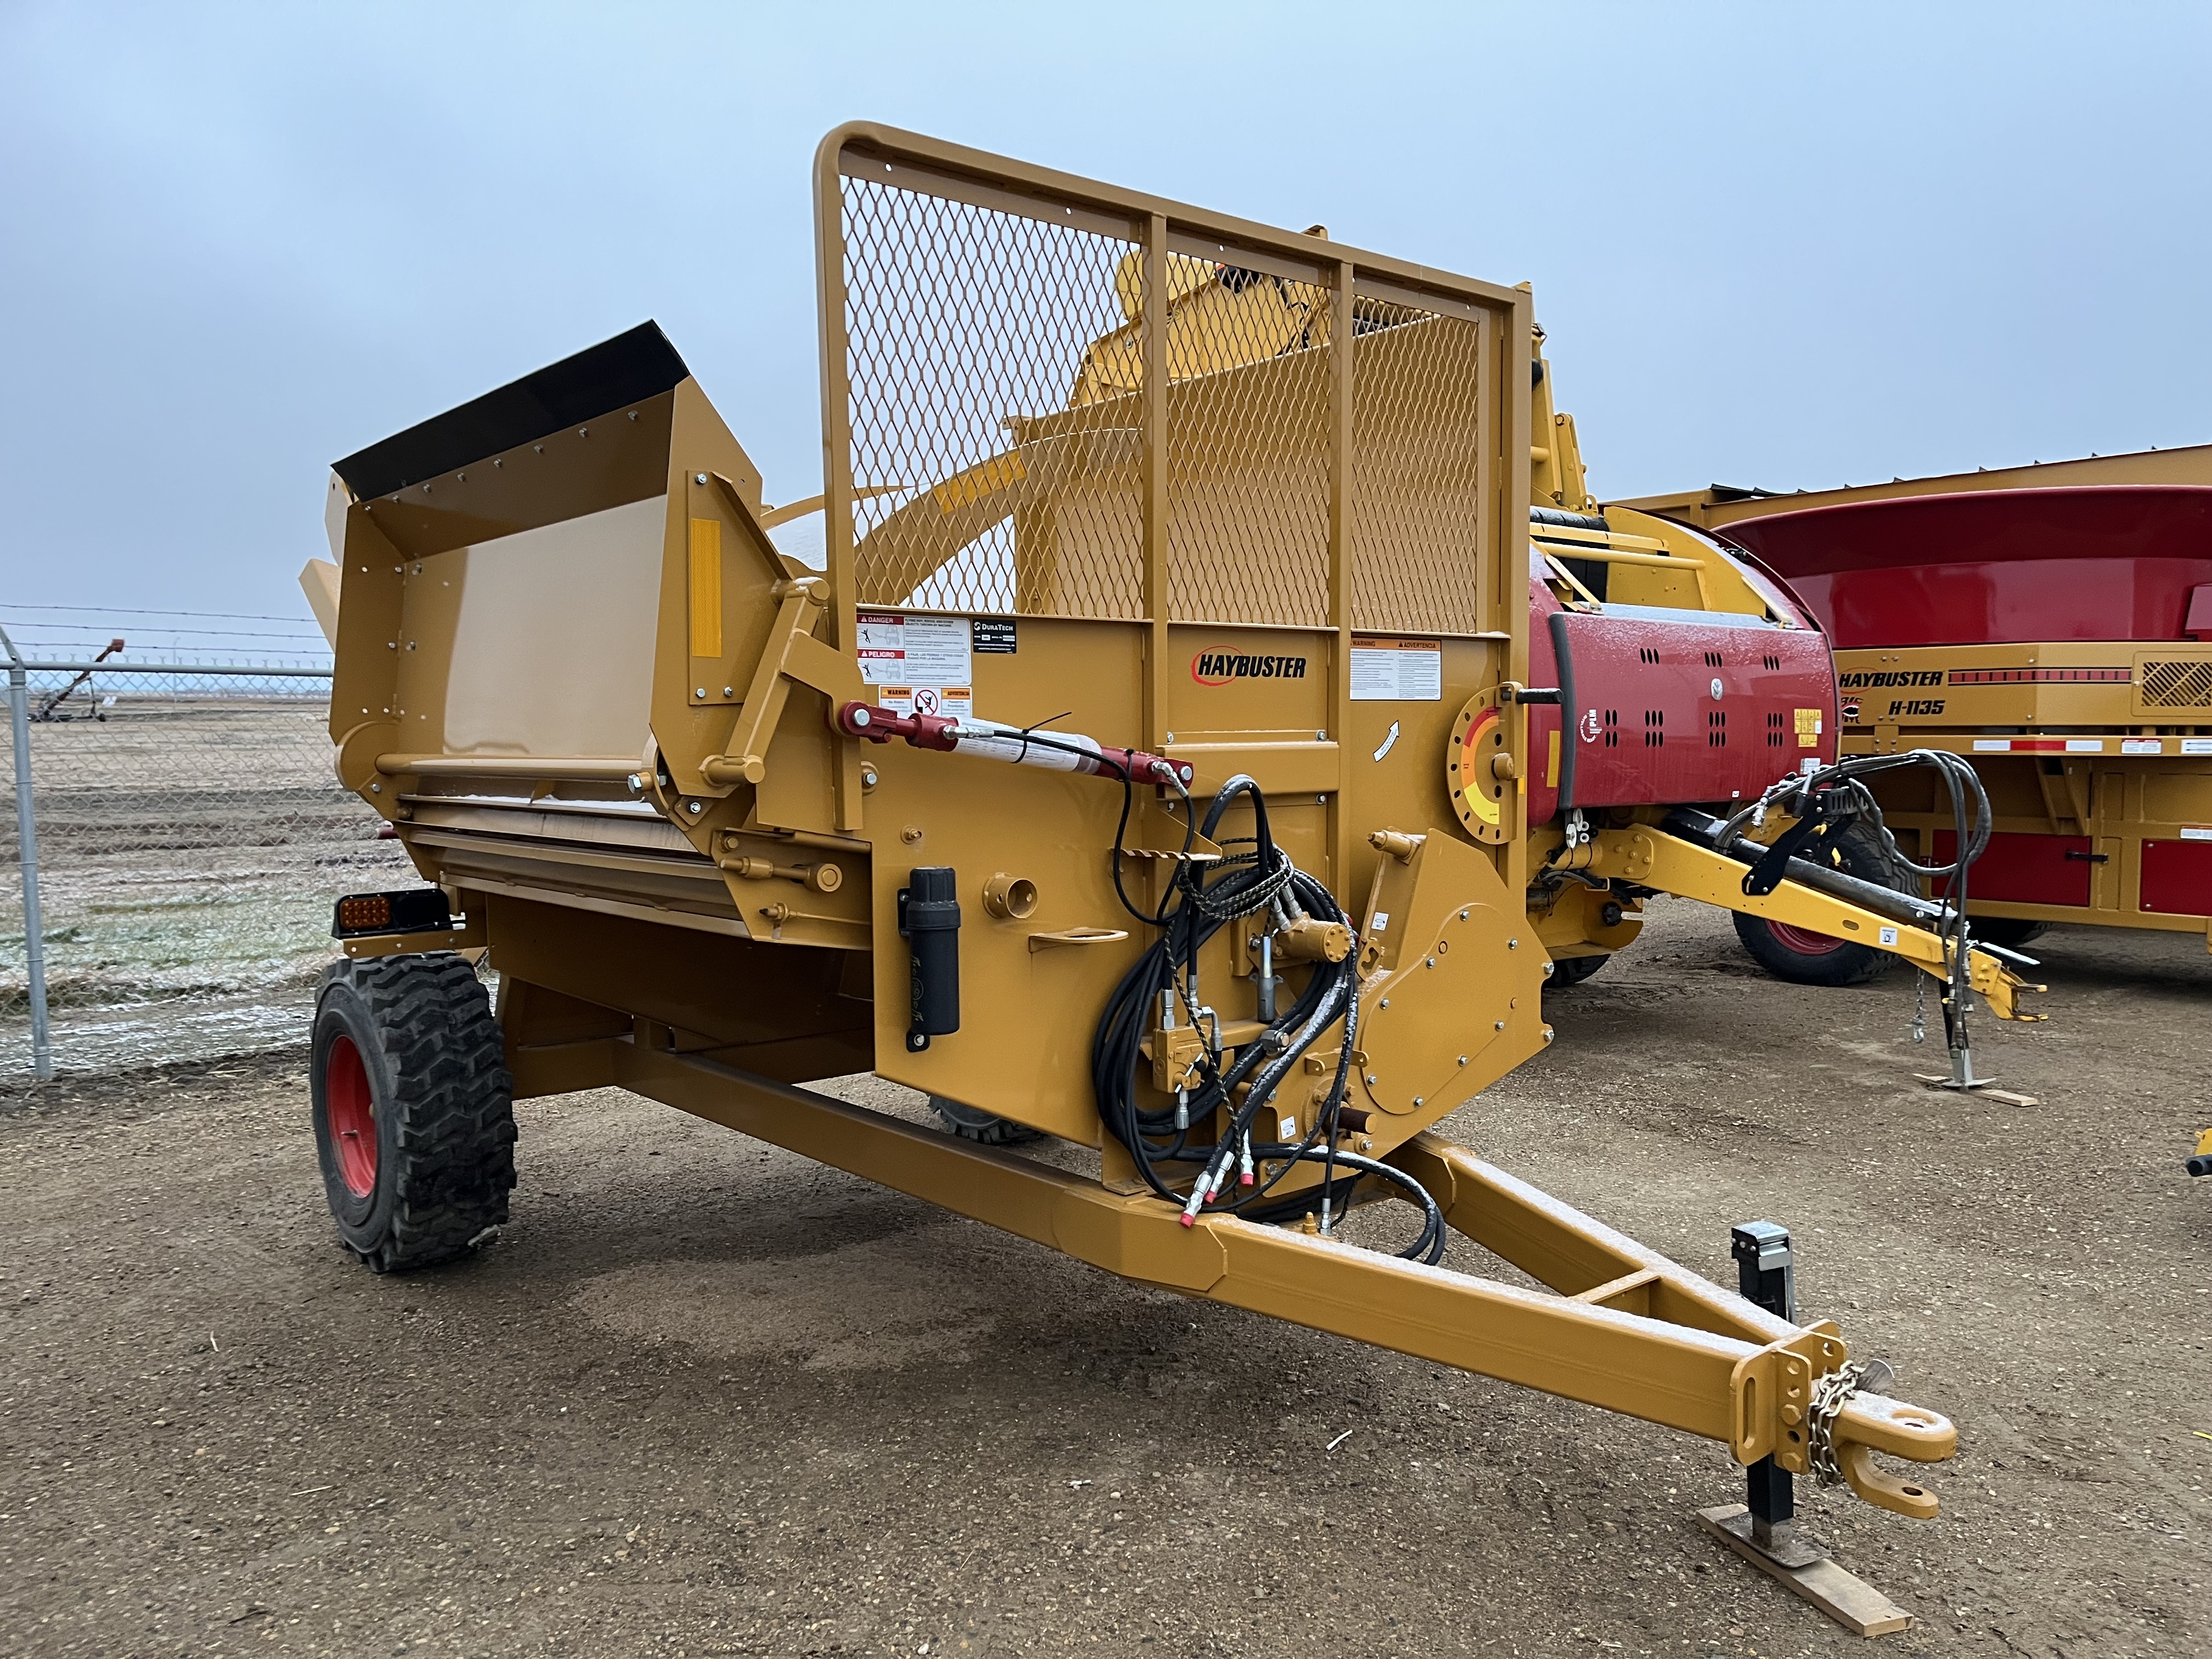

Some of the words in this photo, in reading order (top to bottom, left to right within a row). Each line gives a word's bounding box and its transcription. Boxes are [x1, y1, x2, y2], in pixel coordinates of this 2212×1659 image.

[1198, 654, 1306, 678] HAYBUSTER
[1839, 671, 1943, 687] HAYBUSTER
[1888, 700, 1945, 715] H-1135
